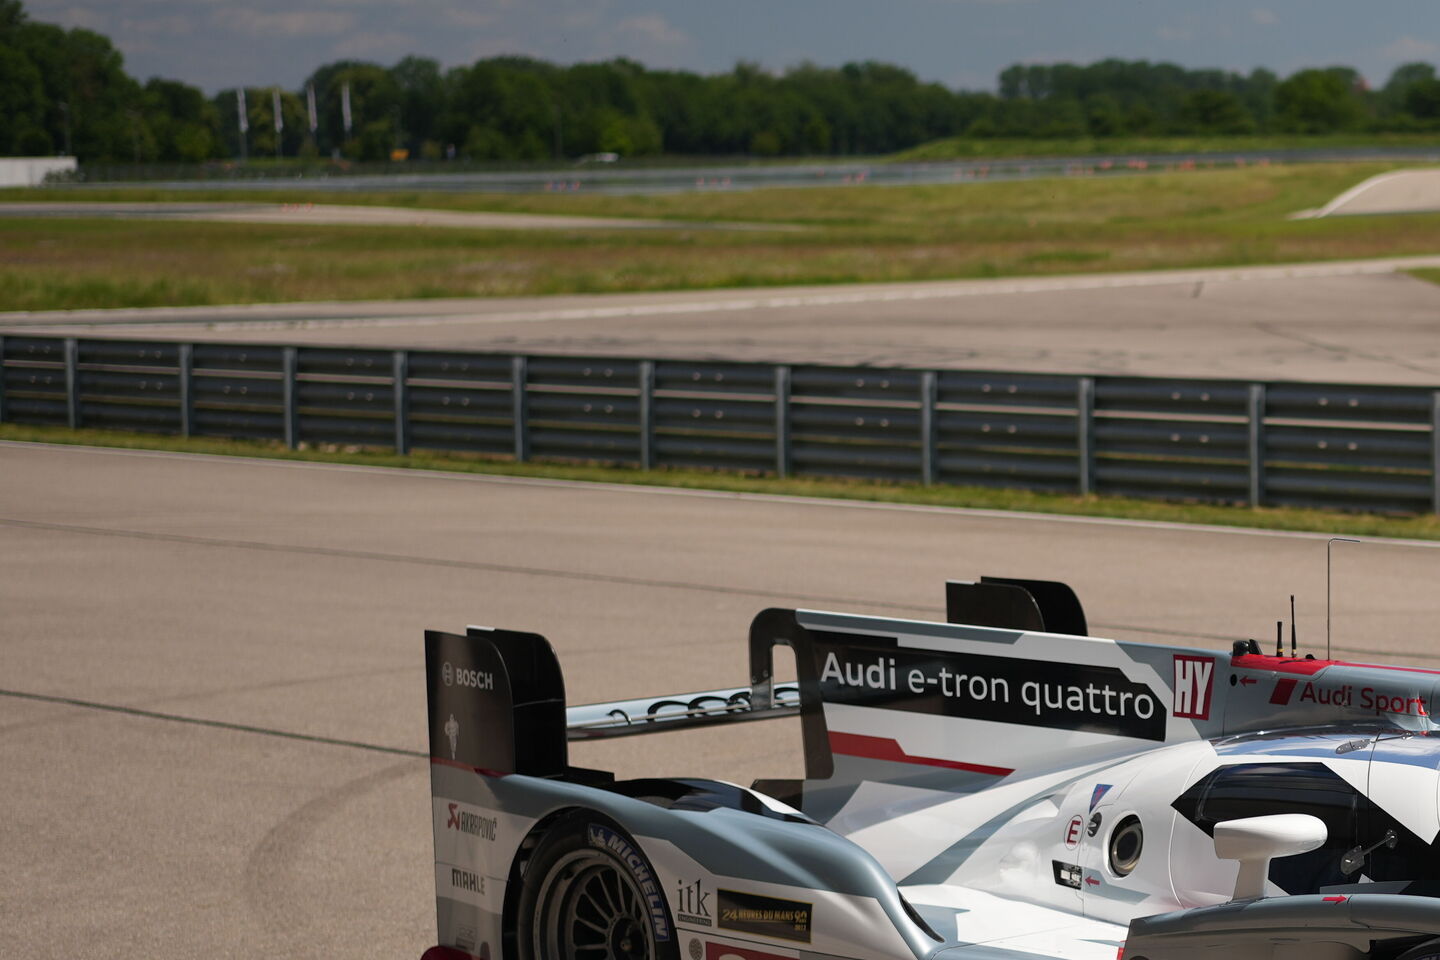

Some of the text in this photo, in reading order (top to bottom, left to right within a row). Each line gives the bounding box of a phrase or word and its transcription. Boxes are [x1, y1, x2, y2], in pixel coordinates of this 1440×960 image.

[456, 668, 494, 690] BOSCH
[821, 652, 1155, 719] Audi e-tron quattro
[1174, 658, 1213, 716] HY
[1300, 681, 1427, 717] Audi Sport
[1066, 820, 1081, 845] E
[451, 868, 485, 895] MAHLE
[607, 834, 668, 937] MICHELIN
[677, 878, 711, 917] itk
[722, 909, 738, 921] 24
